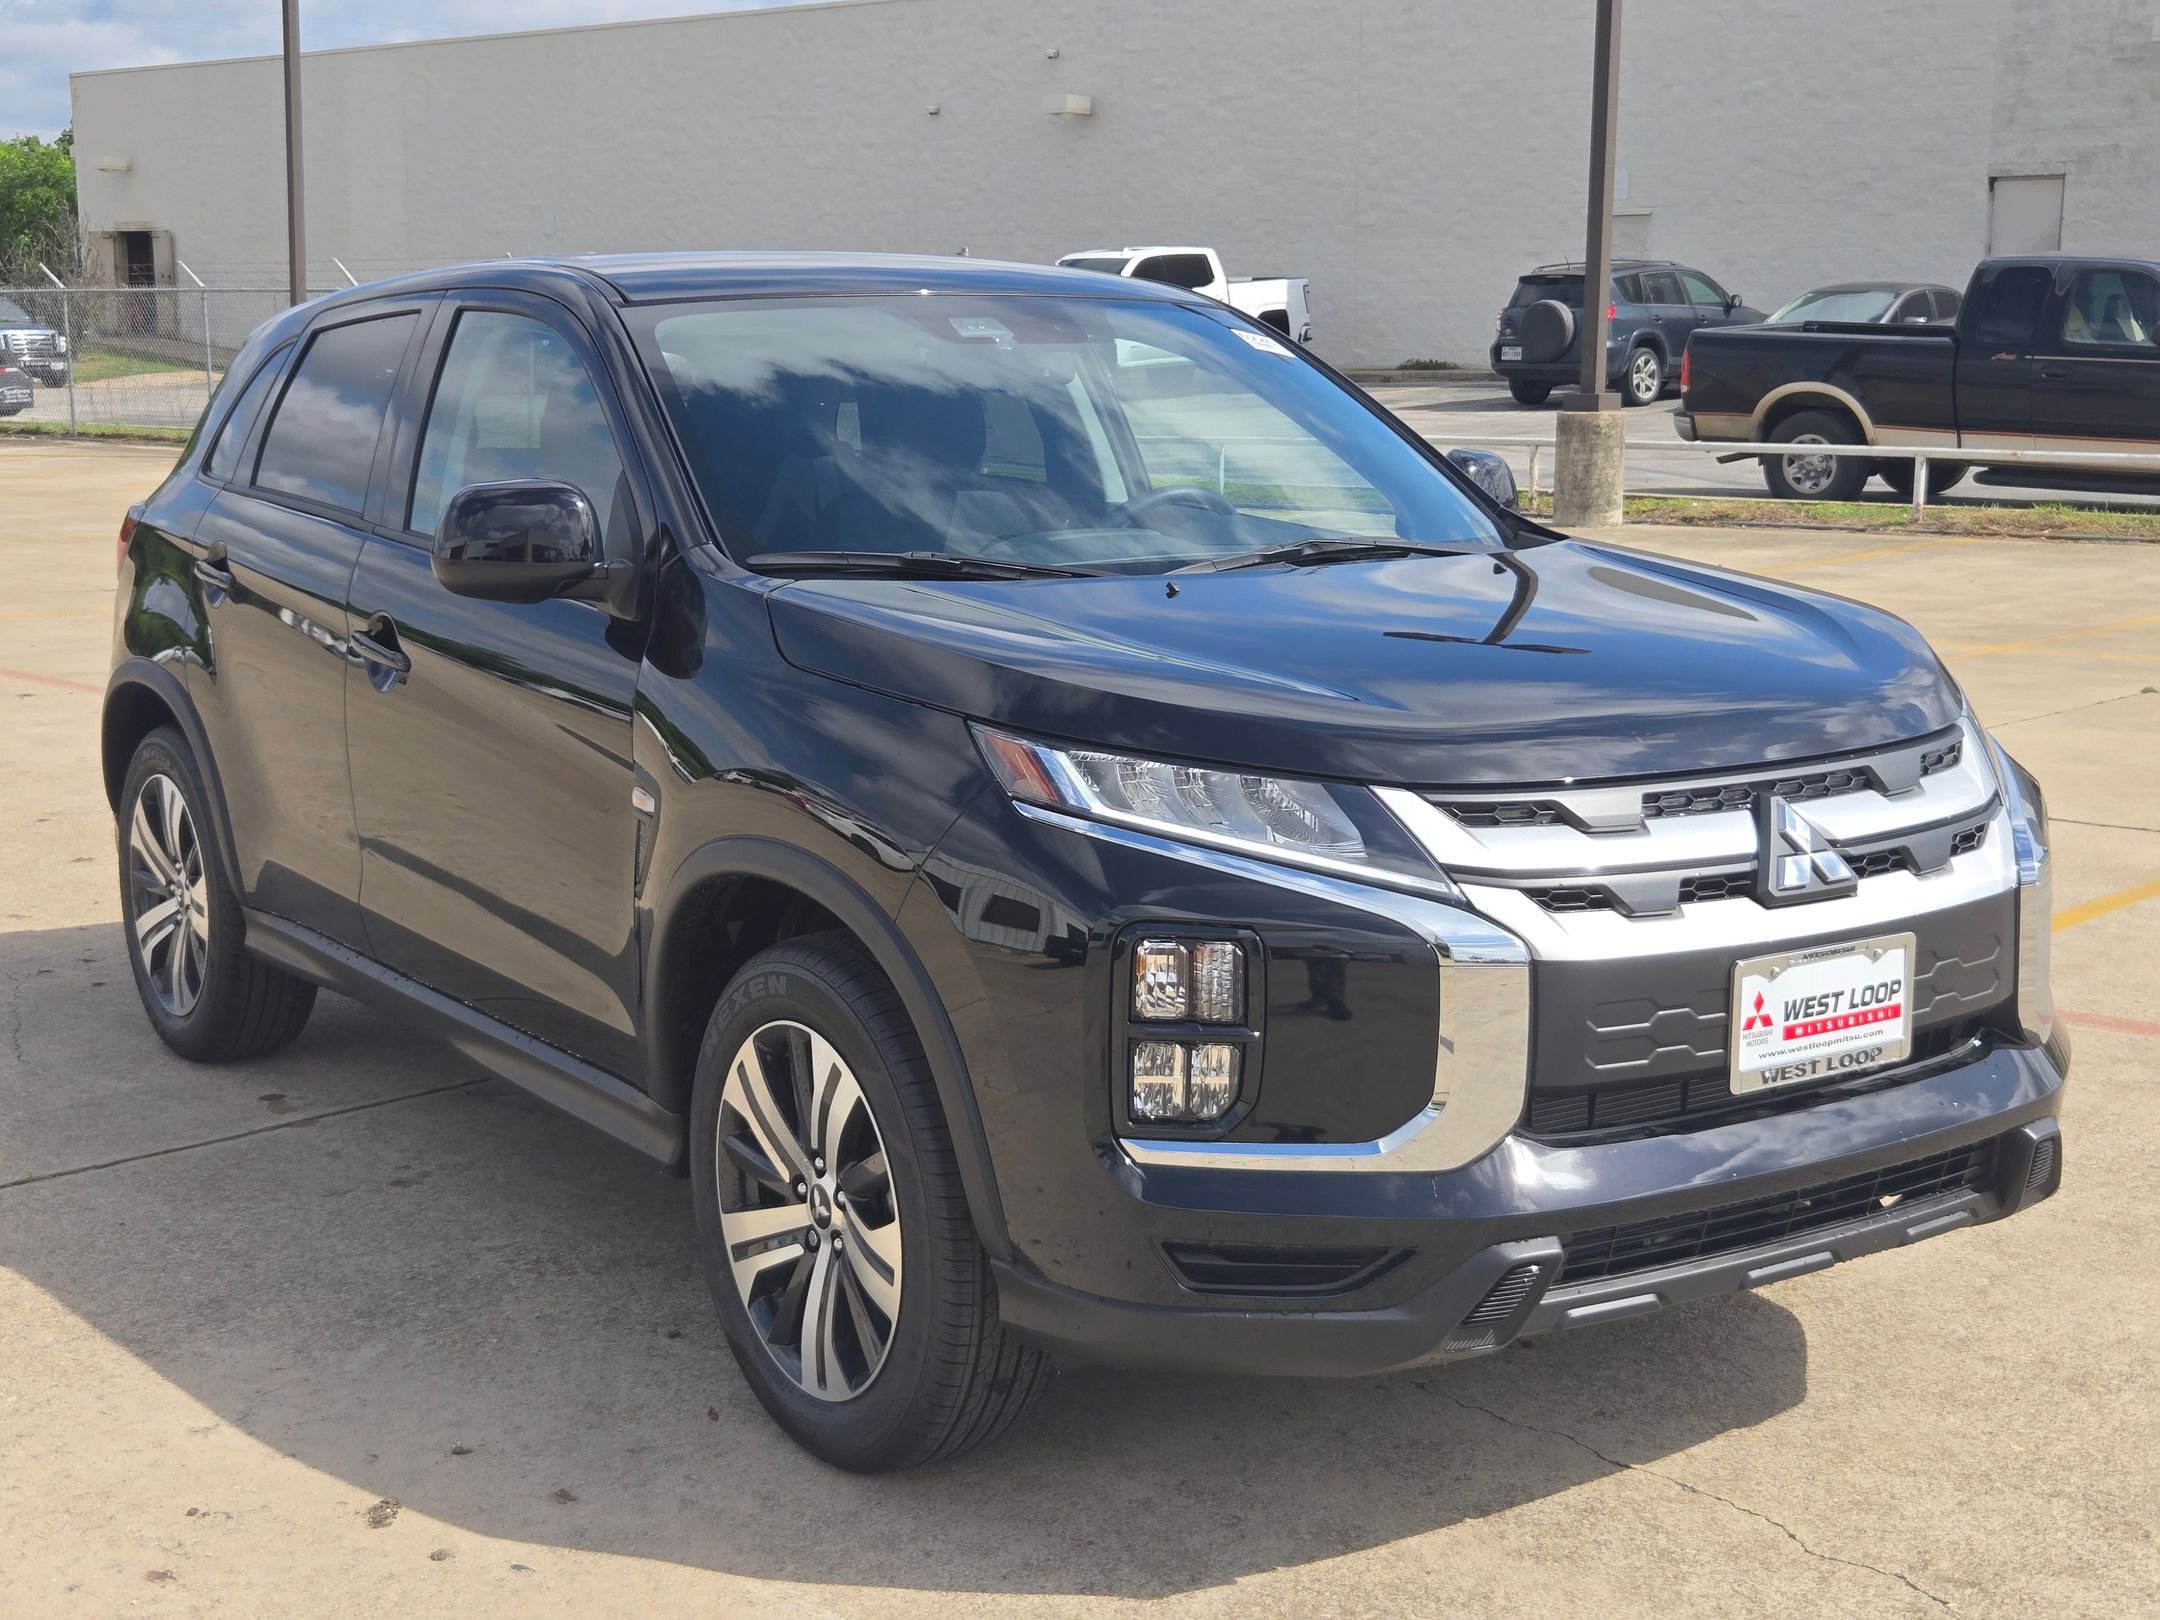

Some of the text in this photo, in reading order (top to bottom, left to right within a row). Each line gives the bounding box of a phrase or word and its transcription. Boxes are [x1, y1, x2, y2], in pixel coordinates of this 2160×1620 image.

[1783, 978, 1902, 1022] WEST LOOP
[1794, 1007, 1893, 1036] MITSUBISHI
[1758, 1029, 1884, 1060] www.westloopmitsu.com
[1760, 1046, 1884, 1085] WEST LOOP
